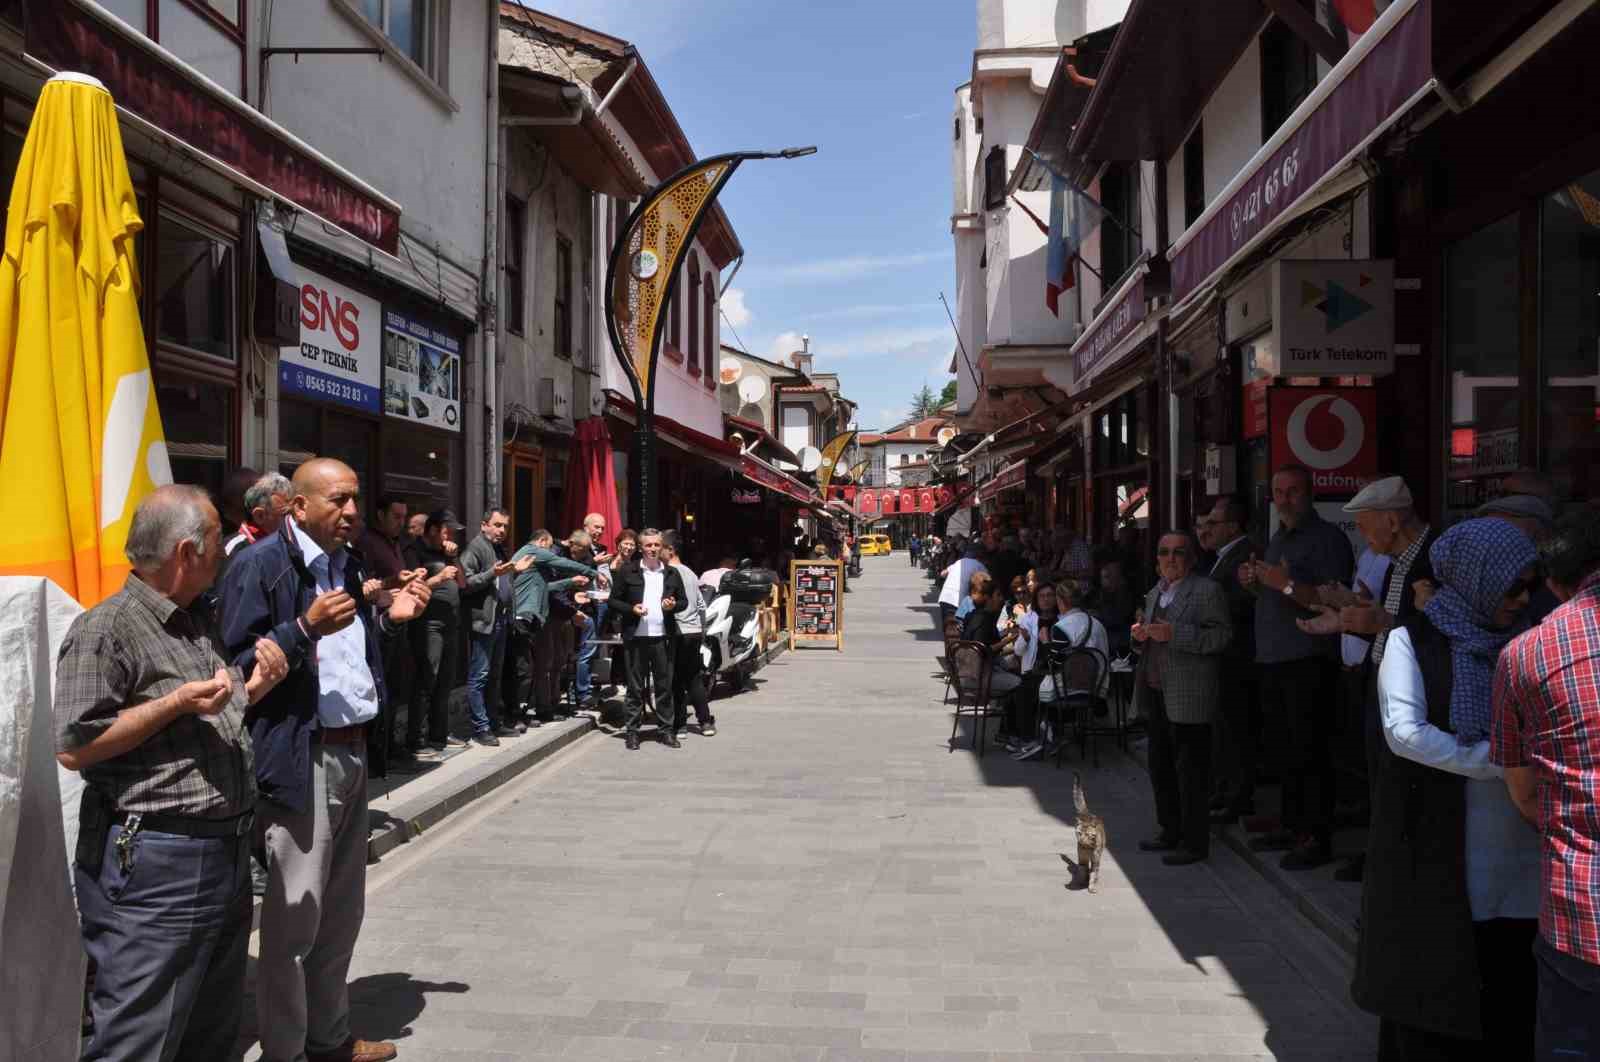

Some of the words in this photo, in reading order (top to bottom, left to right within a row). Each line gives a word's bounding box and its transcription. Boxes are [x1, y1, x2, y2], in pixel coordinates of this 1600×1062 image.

[1242, 185, 1261, 225] 421
[1264, 167, 1280, 205] 65
[1282, 147, 1299, 187] 65
[300, 284, 360, 351] SNS
[301, 342, 320, 360] CEP
[322, 349, 358, 373] TEKNİK
[1288, 347, 1321, 361] Türk
[1325, 347, 1387, 361] Telekom
[305, 375, 326, 393] 0545
[326, 380, 341, 397] 522
[342, 385, 352, 399] 32
[352, 387, 361, 402] 83
